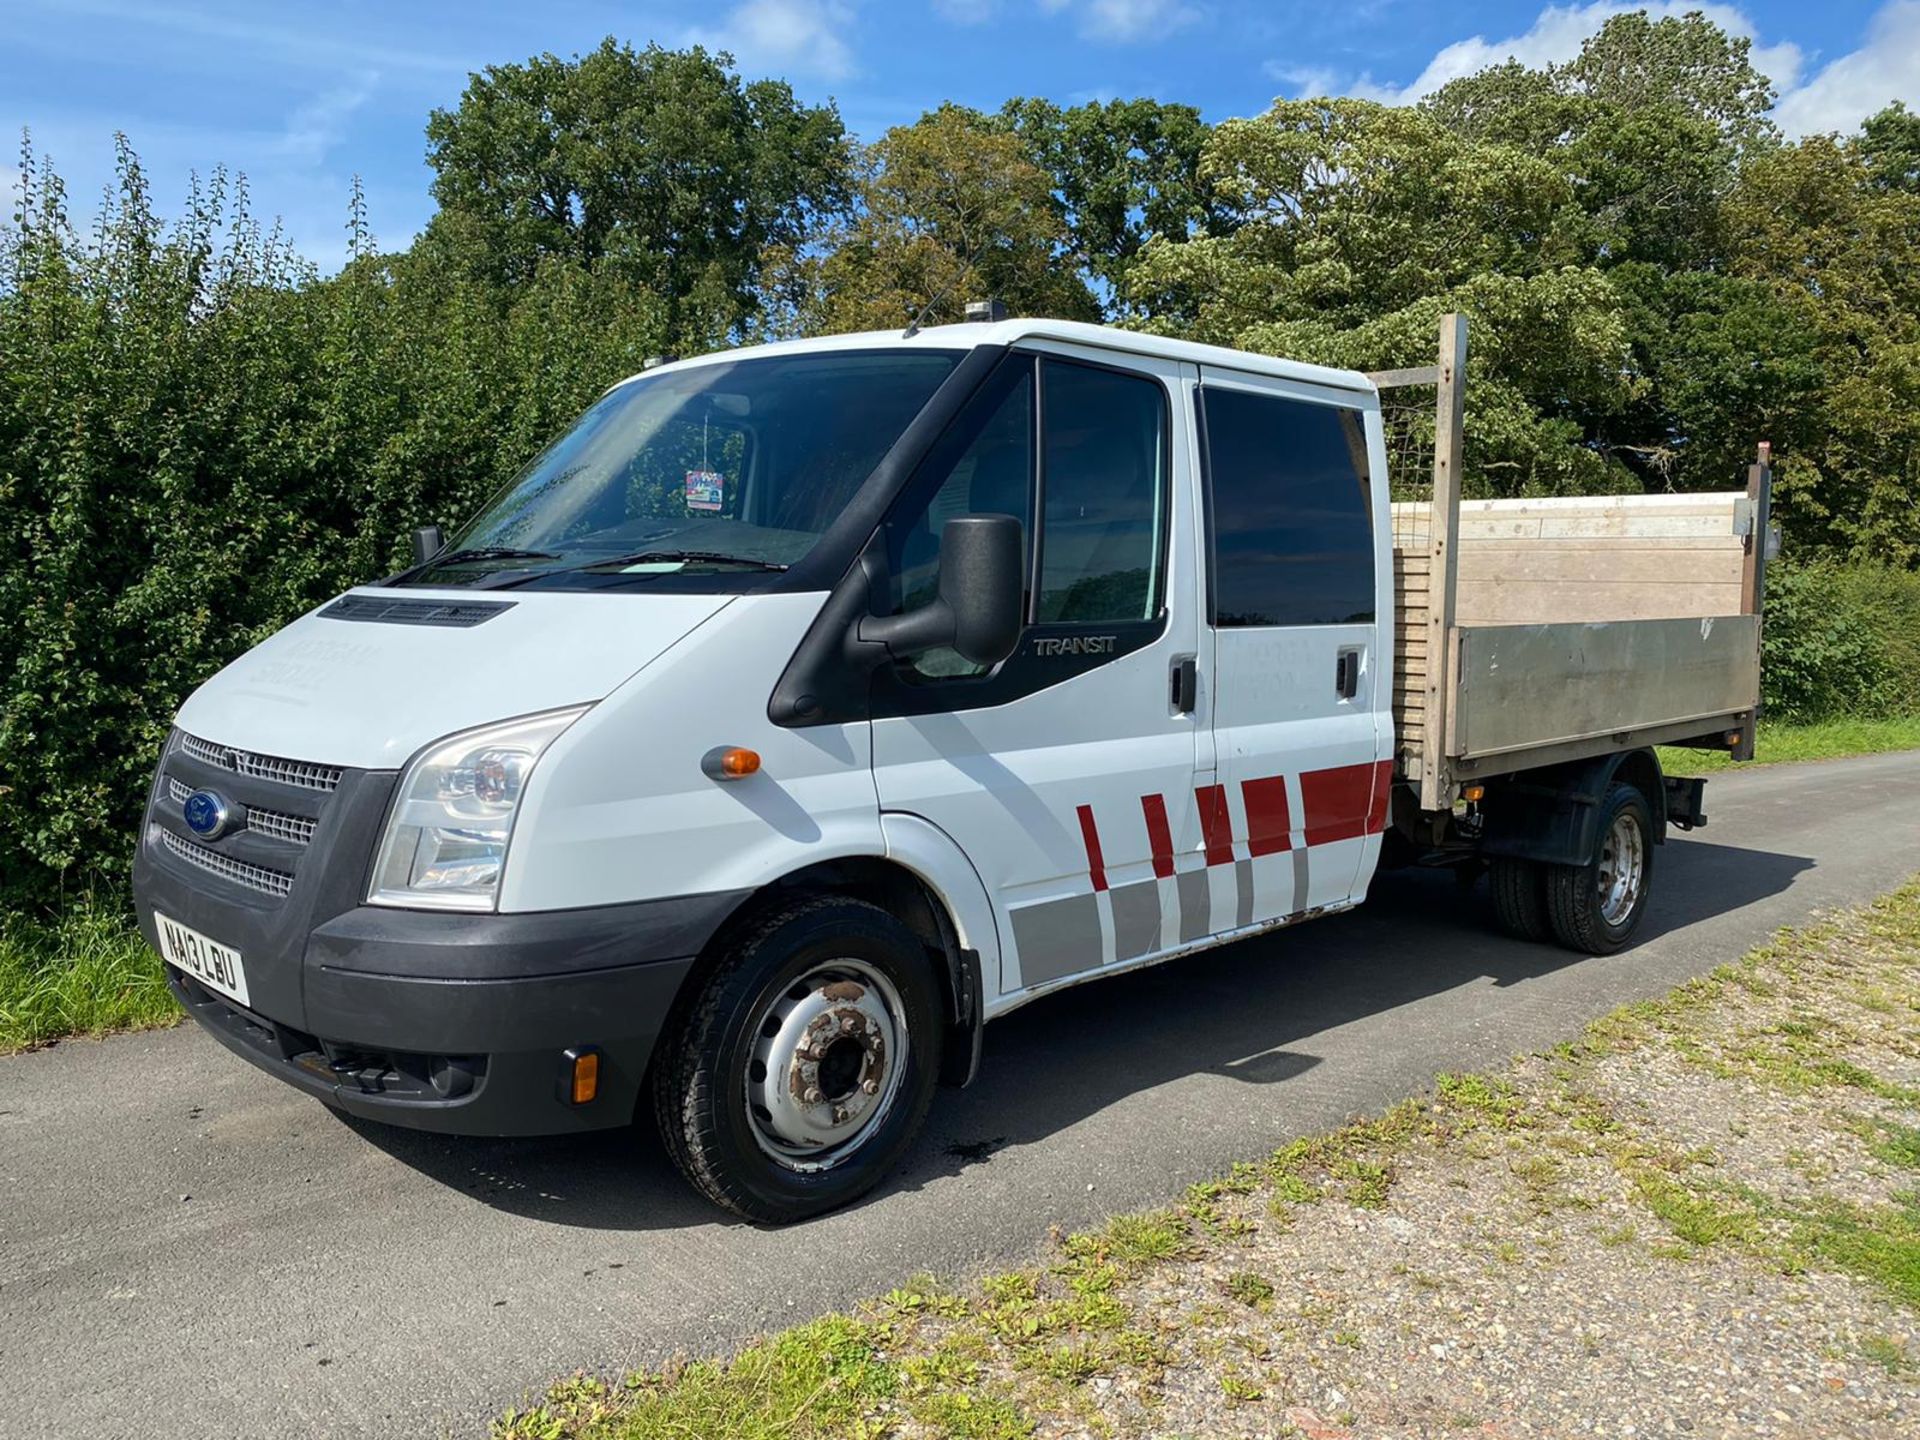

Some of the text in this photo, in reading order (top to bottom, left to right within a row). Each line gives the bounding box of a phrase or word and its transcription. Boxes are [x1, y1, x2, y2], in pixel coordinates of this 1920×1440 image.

[1033, 636, 1117, 656] TRANSIT
[164, 920, 236, 992] NA13 LBU
